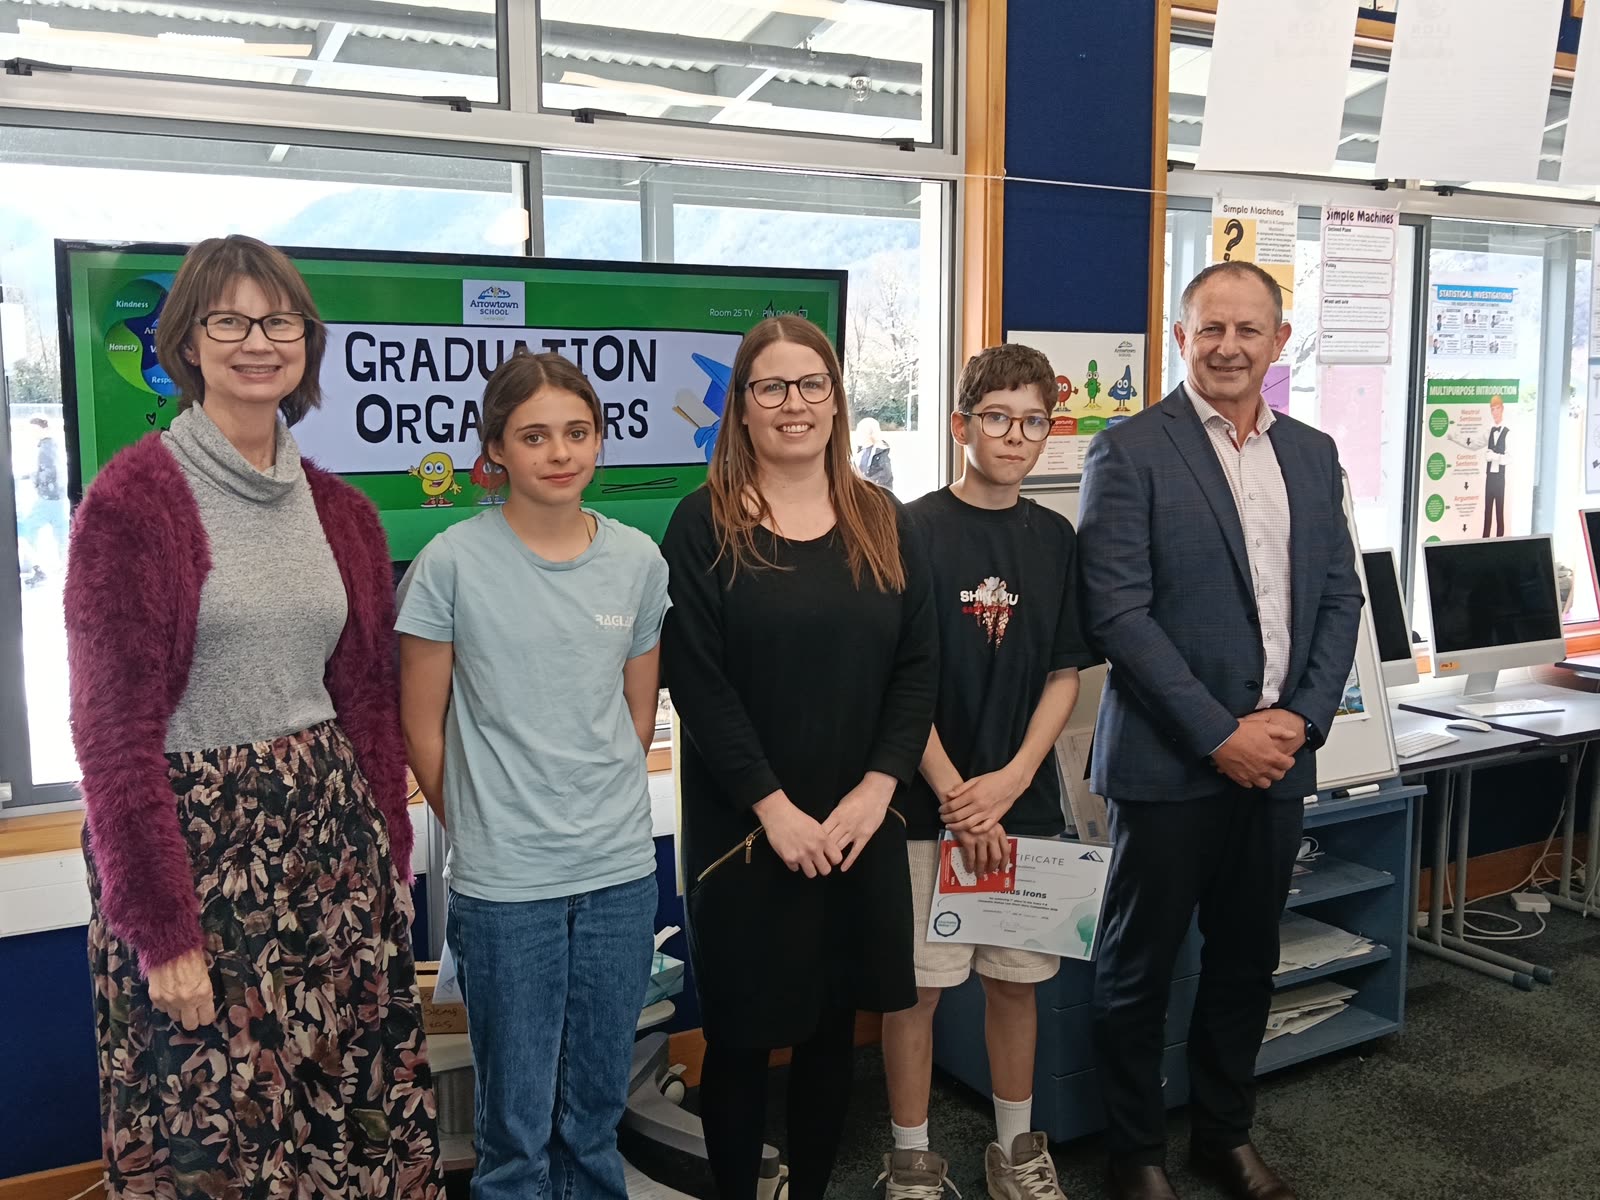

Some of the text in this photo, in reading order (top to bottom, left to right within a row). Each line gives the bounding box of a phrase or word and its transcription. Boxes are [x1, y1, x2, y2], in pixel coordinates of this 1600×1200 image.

[1223, 204, 1285, 217] Simple Machines
[1326, 208, 1394, 226] Simple Machines
[116, 300, 149, 309] Kindness
[470, 299, 519, 309] Arrowtown
[709, 308, 732, 317] Room
[733, 309, 742, 317] 25
[743, 309, 754, 317] TV
[109, 343, 138, 352] Honesty
[1429, 385, 1517, 396] MULTIPURPOSE INTRODUCTION
[1022, 889, 1048, 899] Irons
